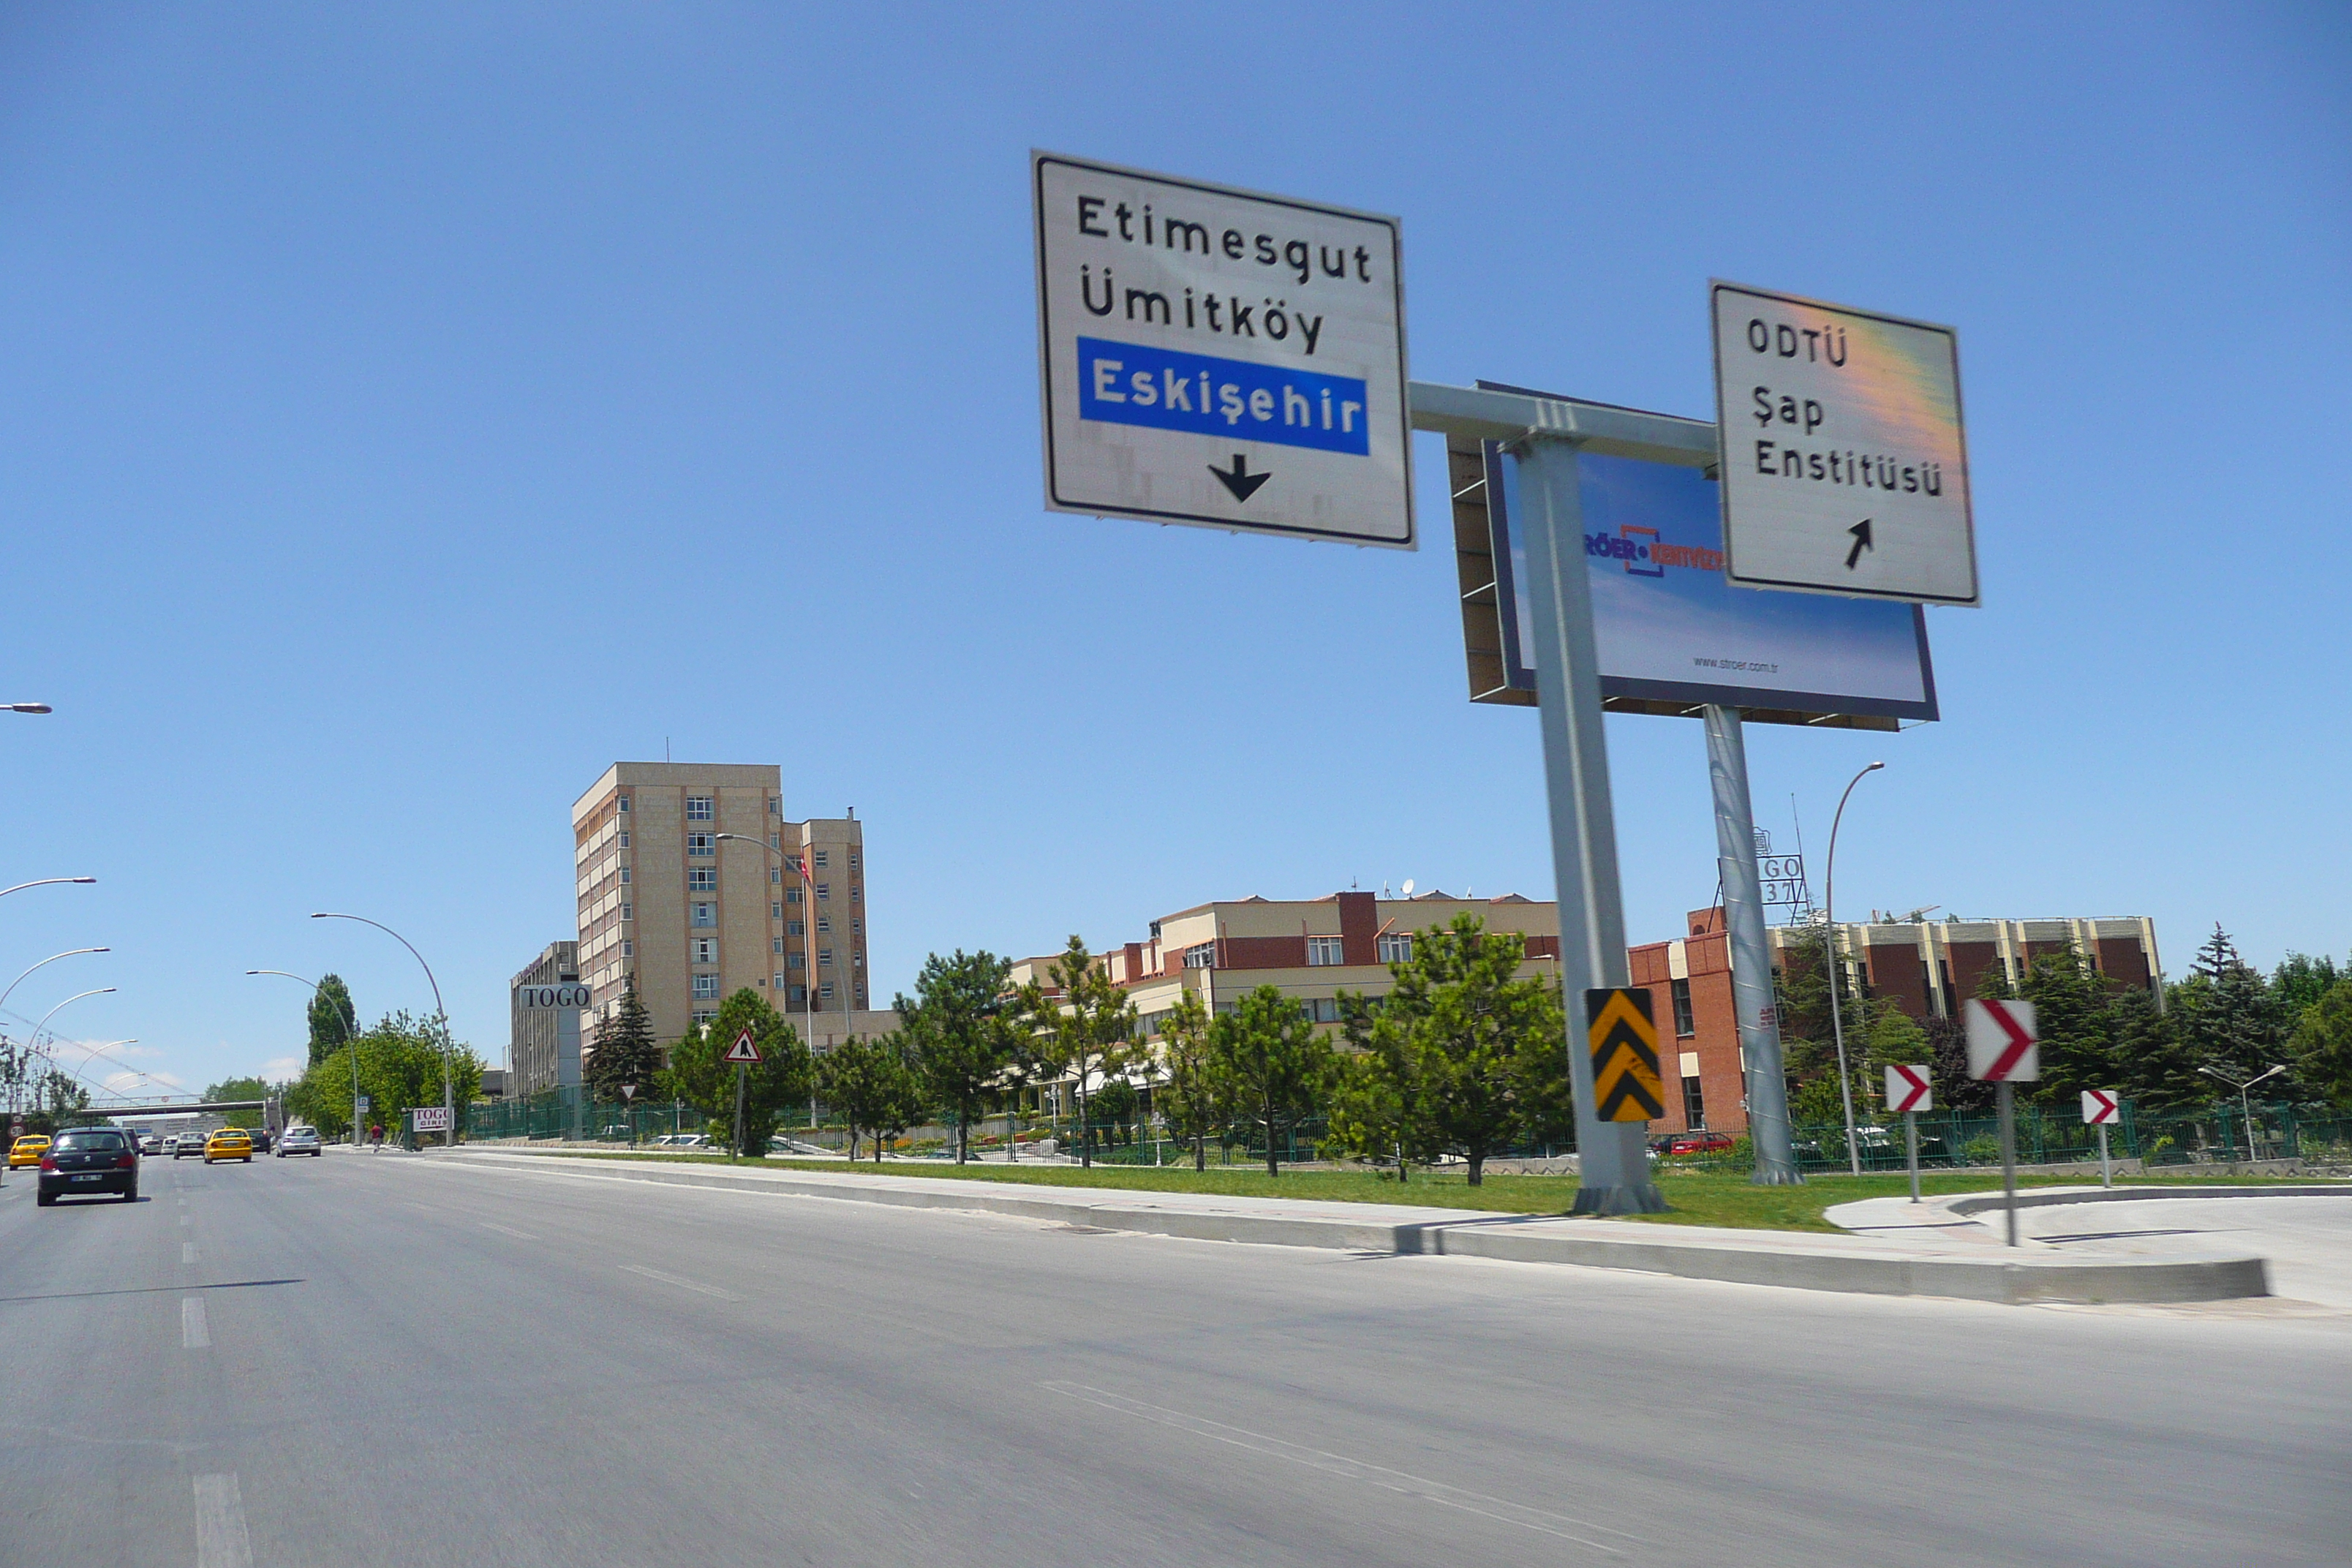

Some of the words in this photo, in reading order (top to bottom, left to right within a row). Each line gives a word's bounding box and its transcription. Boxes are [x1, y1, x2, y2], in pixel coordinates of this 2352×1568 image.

[1078, 195, 1371, 283] Etimesgut
[1080, 264, 1324, 355] Ümitköy
[1748, 318, 1847, 367] ODTÜ
[1093, 358, 1362, 433] Eskişehir
[1752, 385, 1823, 435] Şap
[1756, 440, 1942, 497] Enstitüsü
[524, 987, 589, 1007] TOGO
